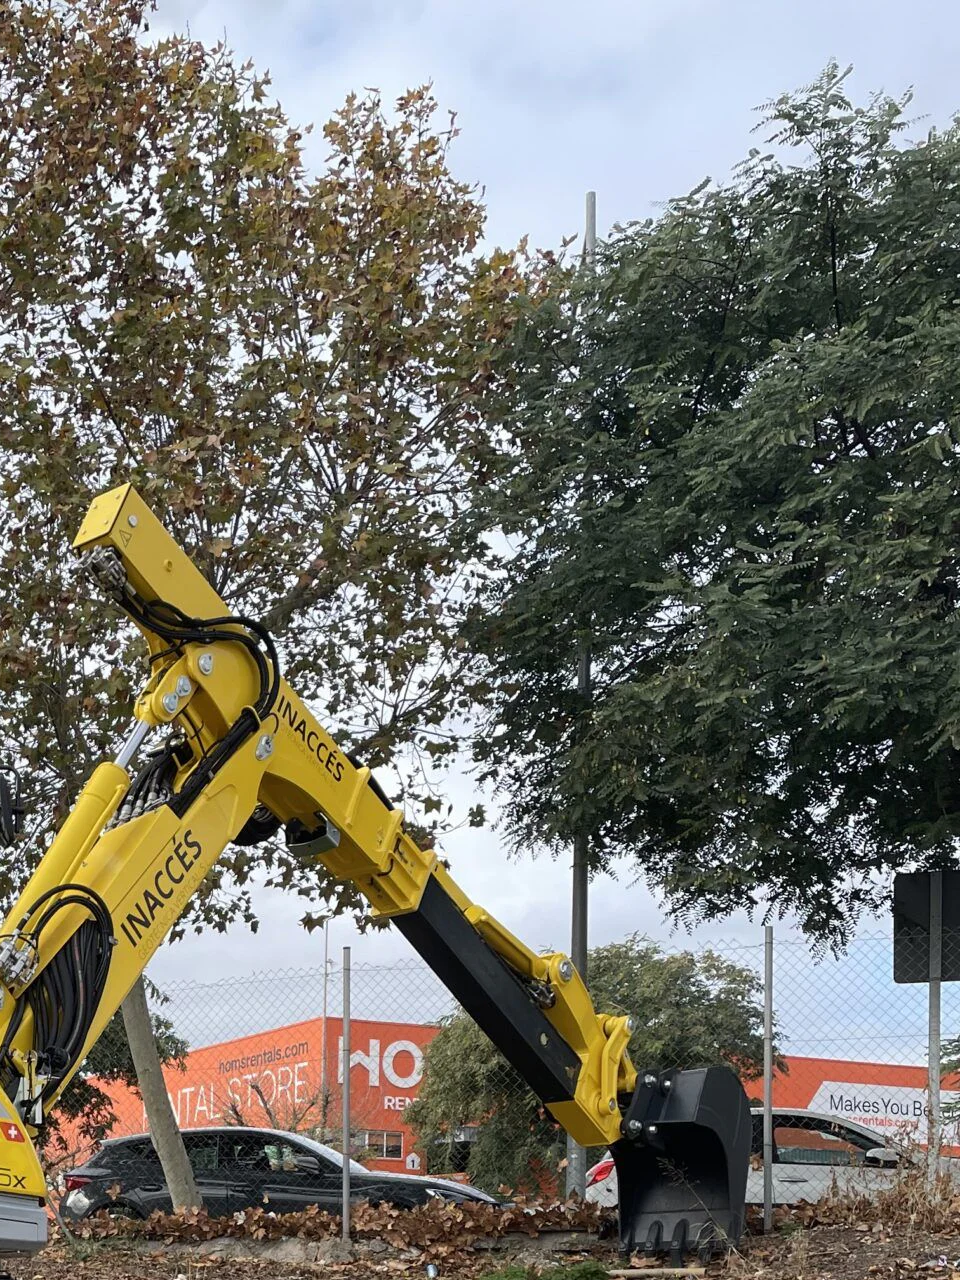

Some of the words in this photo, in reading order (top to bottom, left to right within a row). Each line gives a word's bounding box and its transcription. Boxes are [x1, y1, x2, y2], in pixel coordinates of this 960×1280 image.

[277, 695, 345, 782] INACCÉS
[120, 829, 202, 948] INACCÉS
[219, 1041, 309, 1074] homsrentals.com
[143, 1082, 221, 1132] NTAL
[227, 1062, 309, 1114] STORE
[830, 1095, 880, 1114] Makes
[881, 1098, 909, 1116] You
[410, 1159, 416, 1169] 1
